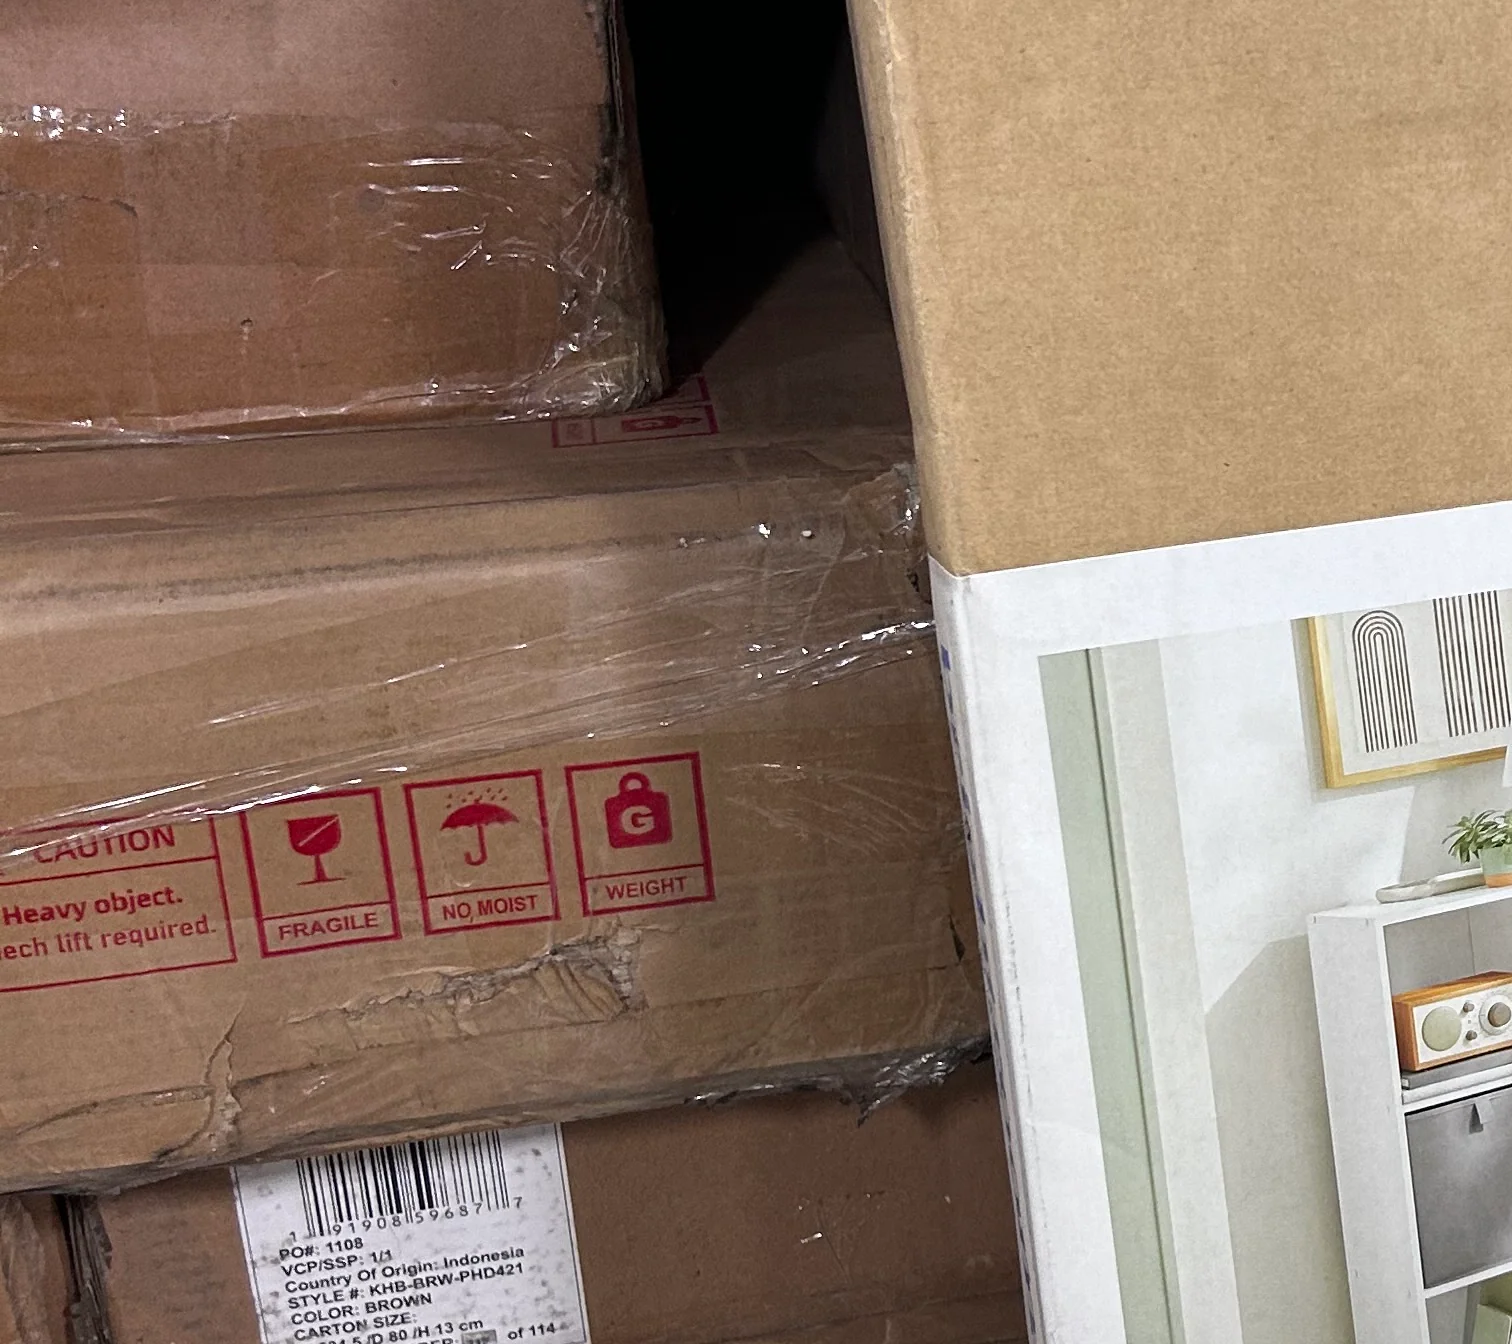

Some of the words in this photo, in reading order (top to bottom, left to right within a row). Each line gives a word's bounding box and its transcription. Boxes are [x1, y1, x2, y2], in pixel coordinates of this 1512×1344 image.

[33, 824, 176, 864] CAUTION
[605, 876, 688, 901] WEIGHT
[2, 900, 87, 926] Heavy
[94, 886, 183, 915] object.
[477, 895, 538, 917] MOIST
[0, 937, 48, 961] ech
[57, 931, 93, 954] lift
[100, 913, 217, 948] required.
[278, 911, 379, 941] FRAGILE
[332, 1216, 402, 1237] 91908
[414, 1201, 483, 1225] 59687
[279, 1244, 321, 1262] PO#:
[326, 1236, 364, 1254] 1108
[281, 1254, 365, 1277] VCP/SSP:
[285, 1273, 352, 1293] Country
[357, 1267, 376, 1282] Of
[381, 1258, 440, 1278] Origin:
[444, 1246, 524, 1269] Indonesia
[288, 1289, 345, 1310] STYLE
[370, 1262, 524, 1296] KHB-BRW-PHD421
[291, 1304, 360, 1326] COLOR:
[365, 1292, 432, 1314] BROWN
[294, 1318, 369, 1341] CARTON
[373, 1312, 418, 1329] SIZE:
[388, 1328, 408, 1343] 80
[436, 1321, 454, 1336] 13
[458, 1318, 484, 1332] cm
[507, 1326, 524, 1341] of
[528, 1321, 555, 1337] 114
